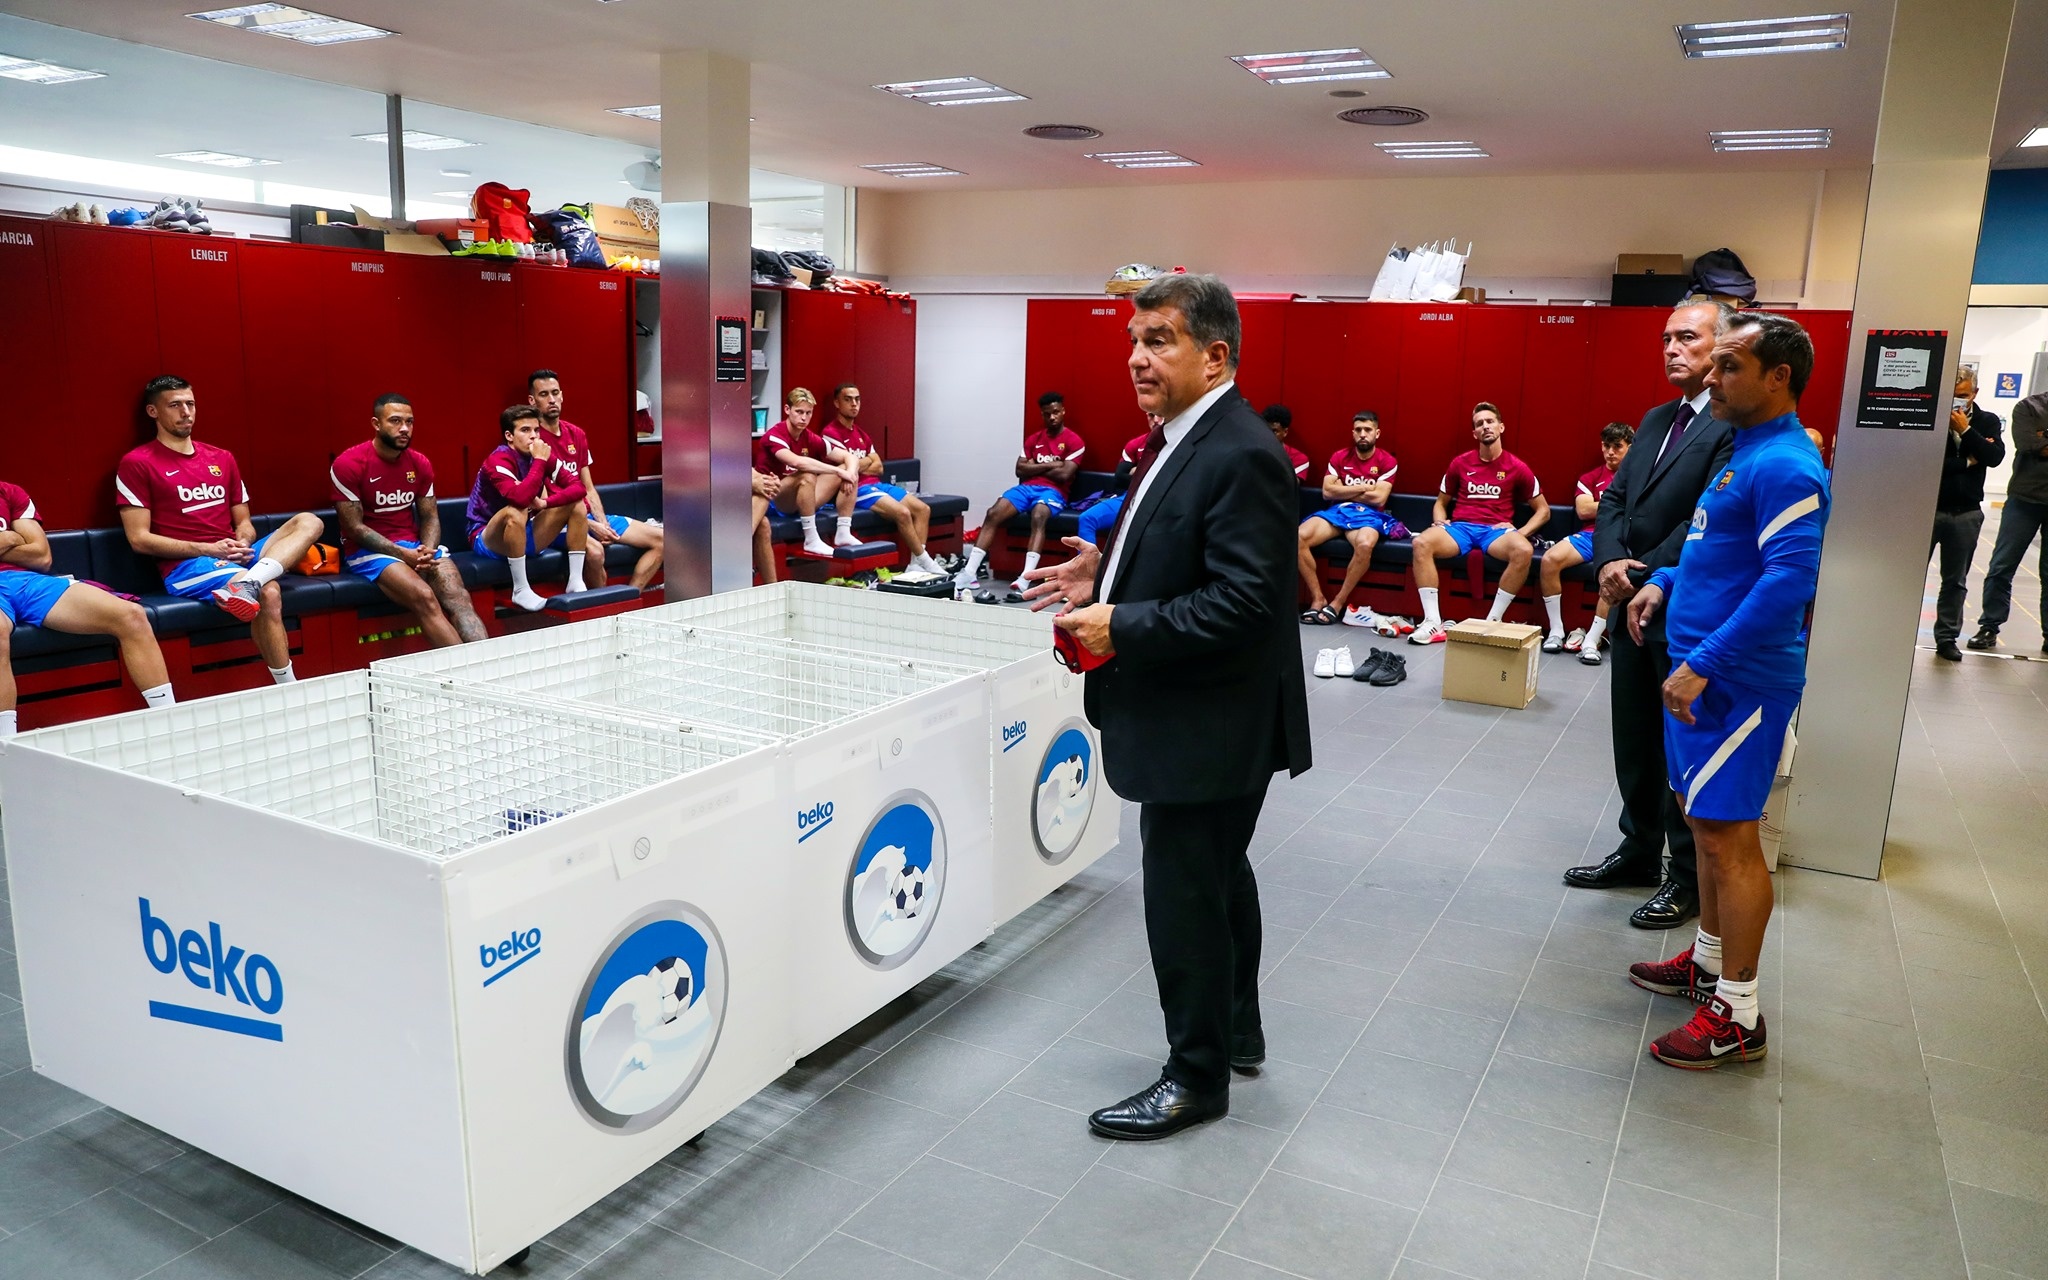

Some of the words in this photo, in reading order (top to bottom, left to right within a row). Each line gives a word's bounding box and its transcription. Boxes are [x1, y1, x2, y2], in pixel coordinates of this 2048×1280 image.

[0, 231, 34, 246] ARCIA
[191, 248, 228, 262] LENGLET
[351, 261, 385, 274] MEMPHIS
[481, 270, 497, 282] RIQUI
[497, 272, 512, 282] PUIG
[1419, 312, 1438, 321] JORDI
[1438, 312, 1454, 321] ALBA
[1539, 315, 1546, 324] L.
[1547, 315, 1556, 324] DE
[1556, 315, 1575, 324] JONG
[176, 482, 226, 502] beko
[1467, 481, 1502, 496] beko
[375, 489, 415, 506] beko
[1002, 720, 1027, 742] beko
[797, 801, 834, 830] beko
[138, 895, 284, 1015] beko
[479, 926, 542, 969] beko
